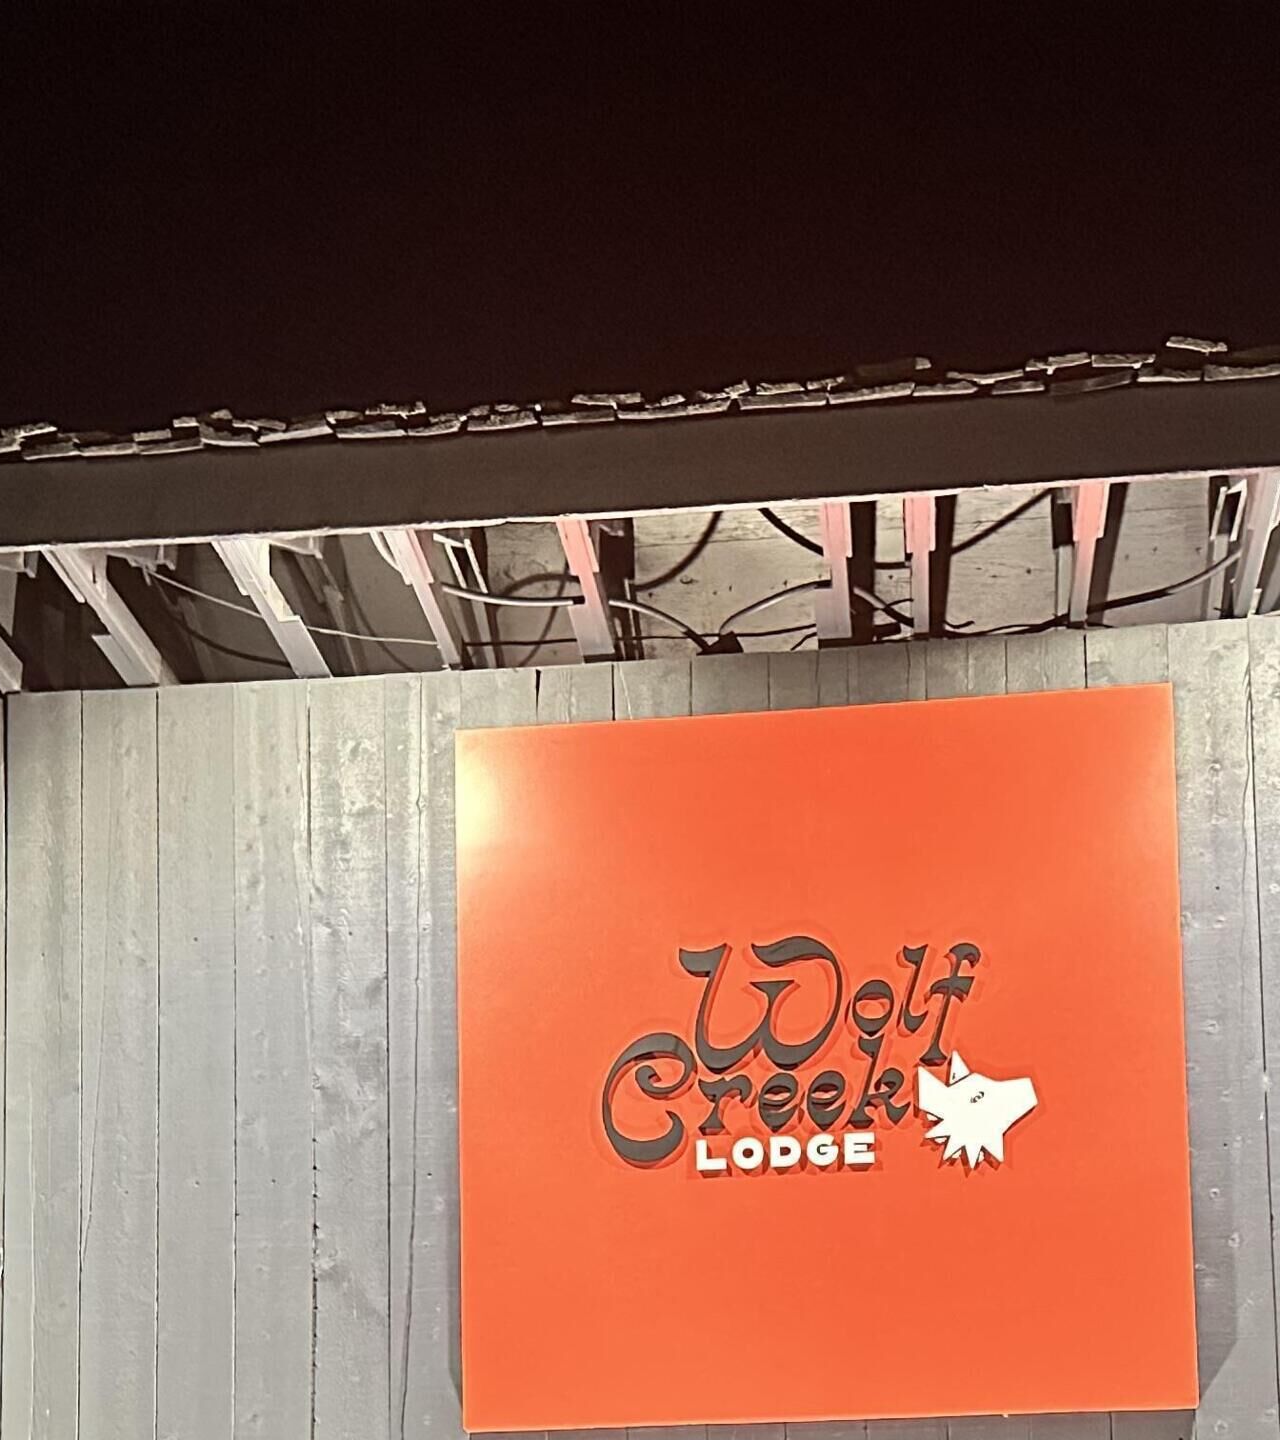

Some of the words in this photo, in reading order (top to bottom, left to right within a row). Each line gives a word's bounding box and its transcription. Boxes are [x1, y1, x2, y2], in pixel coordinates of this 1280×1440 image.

[678, 934, 982, 1072] Wolf
[601, 1032, 913, 1168] Creek
[694, 1130, 878, 1174] LODGE
